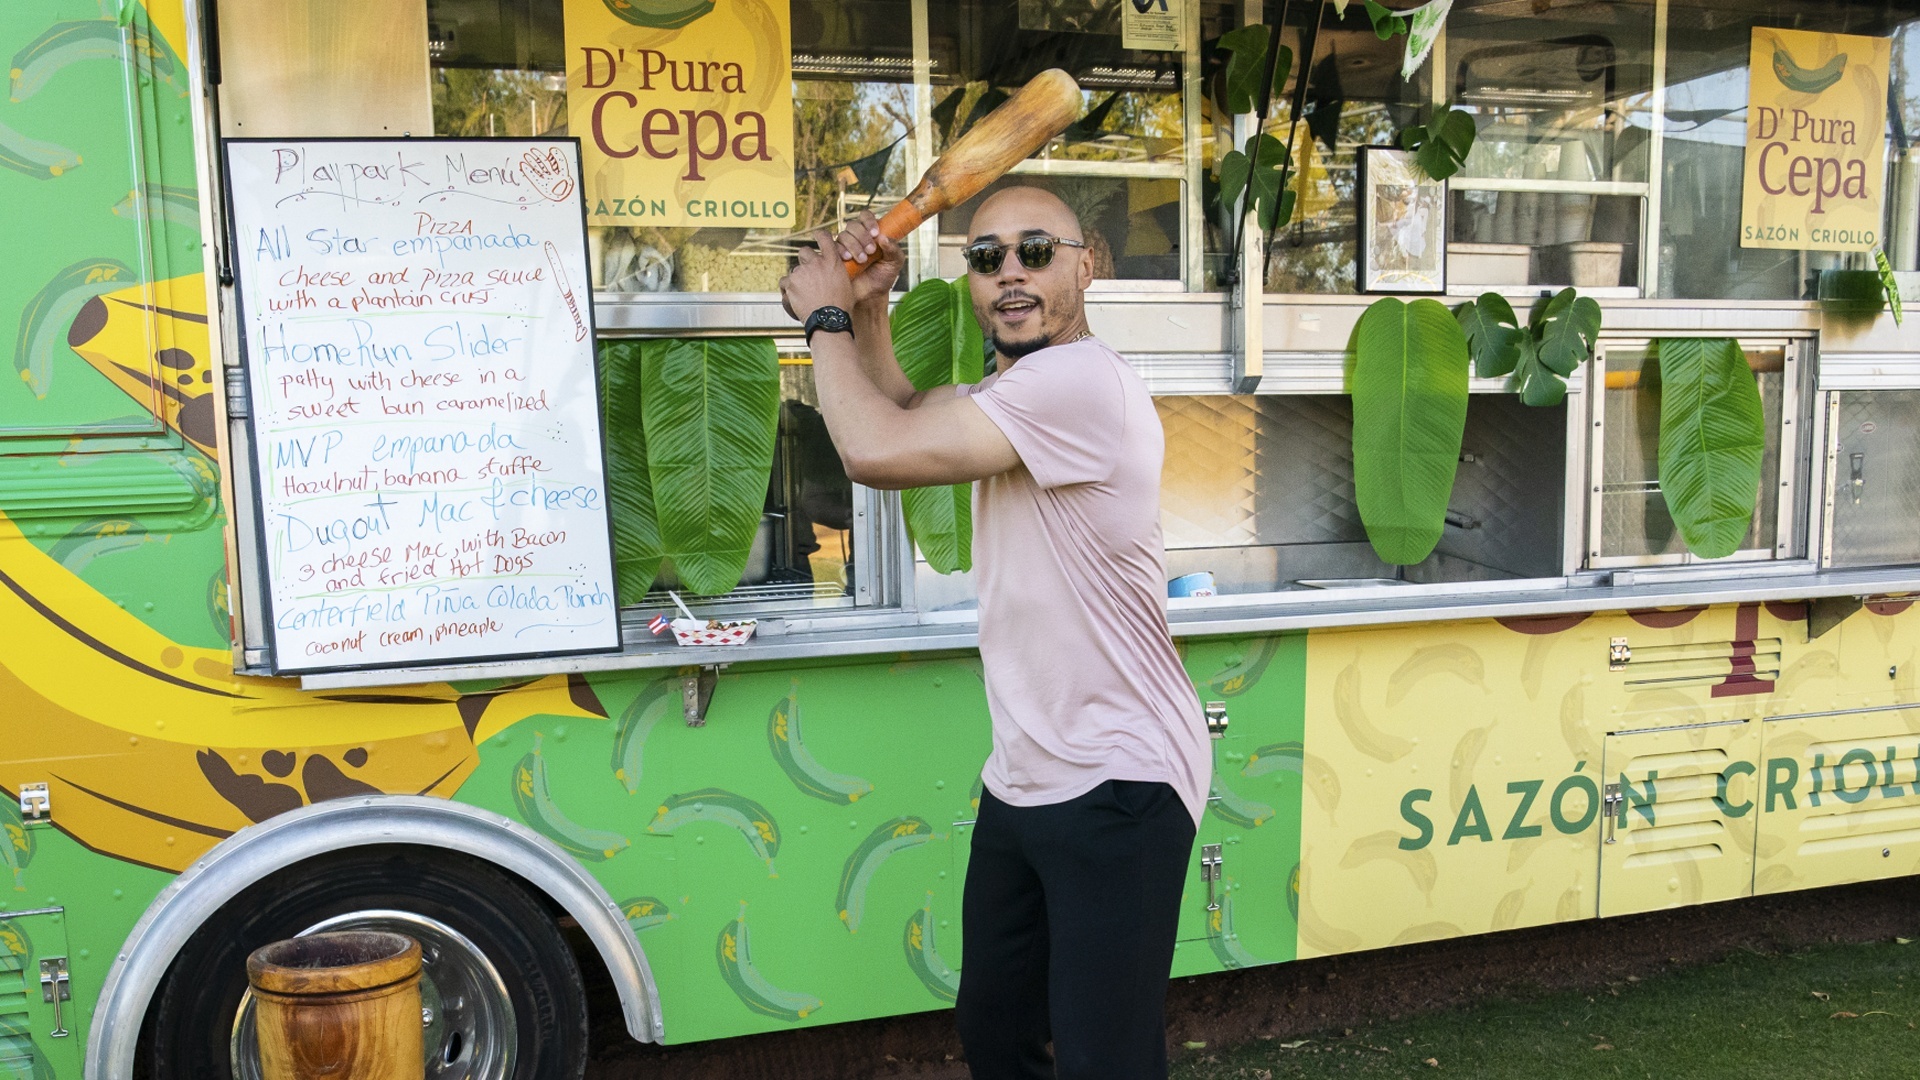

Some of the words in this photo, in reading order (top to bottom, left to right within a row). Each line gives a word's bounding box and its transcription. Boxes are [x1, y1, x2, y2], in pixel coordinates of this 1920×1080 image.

[580, 46, 625, 89] D'
[637, 48, 747, 94] Pura
[591, 90, 772, 181] Cepa
[1755, 106, 1784, 140] D'
[1790, 108, 1856, 145] Pura
[272, 147, 430, 212] Playpark
[445, 152, 520, 187] Menú
[1758, 141, 1868, 214] Cepa
[686, 200, 789, 218] CRIOLLO
[257, 224, 291, 262] All
[306, 228, 379, 255] Star
[393, 224, 540, 269] empanada
[1745, 224, 1799, 241] SAZÓN
[1811, 229, 1875, 245] CRIOLLO
[368, 267, 410, 285] and
[485, 267, 547, 286] sauce
[269, 289, 317, 311] with
[328, 297, 349, 309] a
[352, 287, 433, 313] plantain
[424, 321, 522, 361] Slider
[278, 368, 335, 402] patty
[348, 371, 392, 391] with
[400, 369, 463, 388] cheese
[478, 368, 496, 384] in
[504, 368, 527, 382] a
[288, 397, 360, 420] sweet
[382, 396, 424, 416] bun
[436, 389, 550, 413] caramelized
[276, 430, 344, 469] MVP
[372, 422, 528, 474] empanada
[277, 493, 398, 559] Dugout
[418, 491, 474, 533] Mac
[511, 472, 603, 511] cheese
[299, 564, 316, 582] 3
[322, 547, 392, 575] cheese
[511, 527, 566, 549] Bacon
[326, 570, 365, 593] and
[378, 559, 437, 587] fried
[450, 552, 485, 578] Hot
[486, 585, 558, 611] Colada
[553, 582, 614, 611] Punch
[305, 629, 367, 658] coconut
[1398, 760, 1659, 851] SAZÓN
